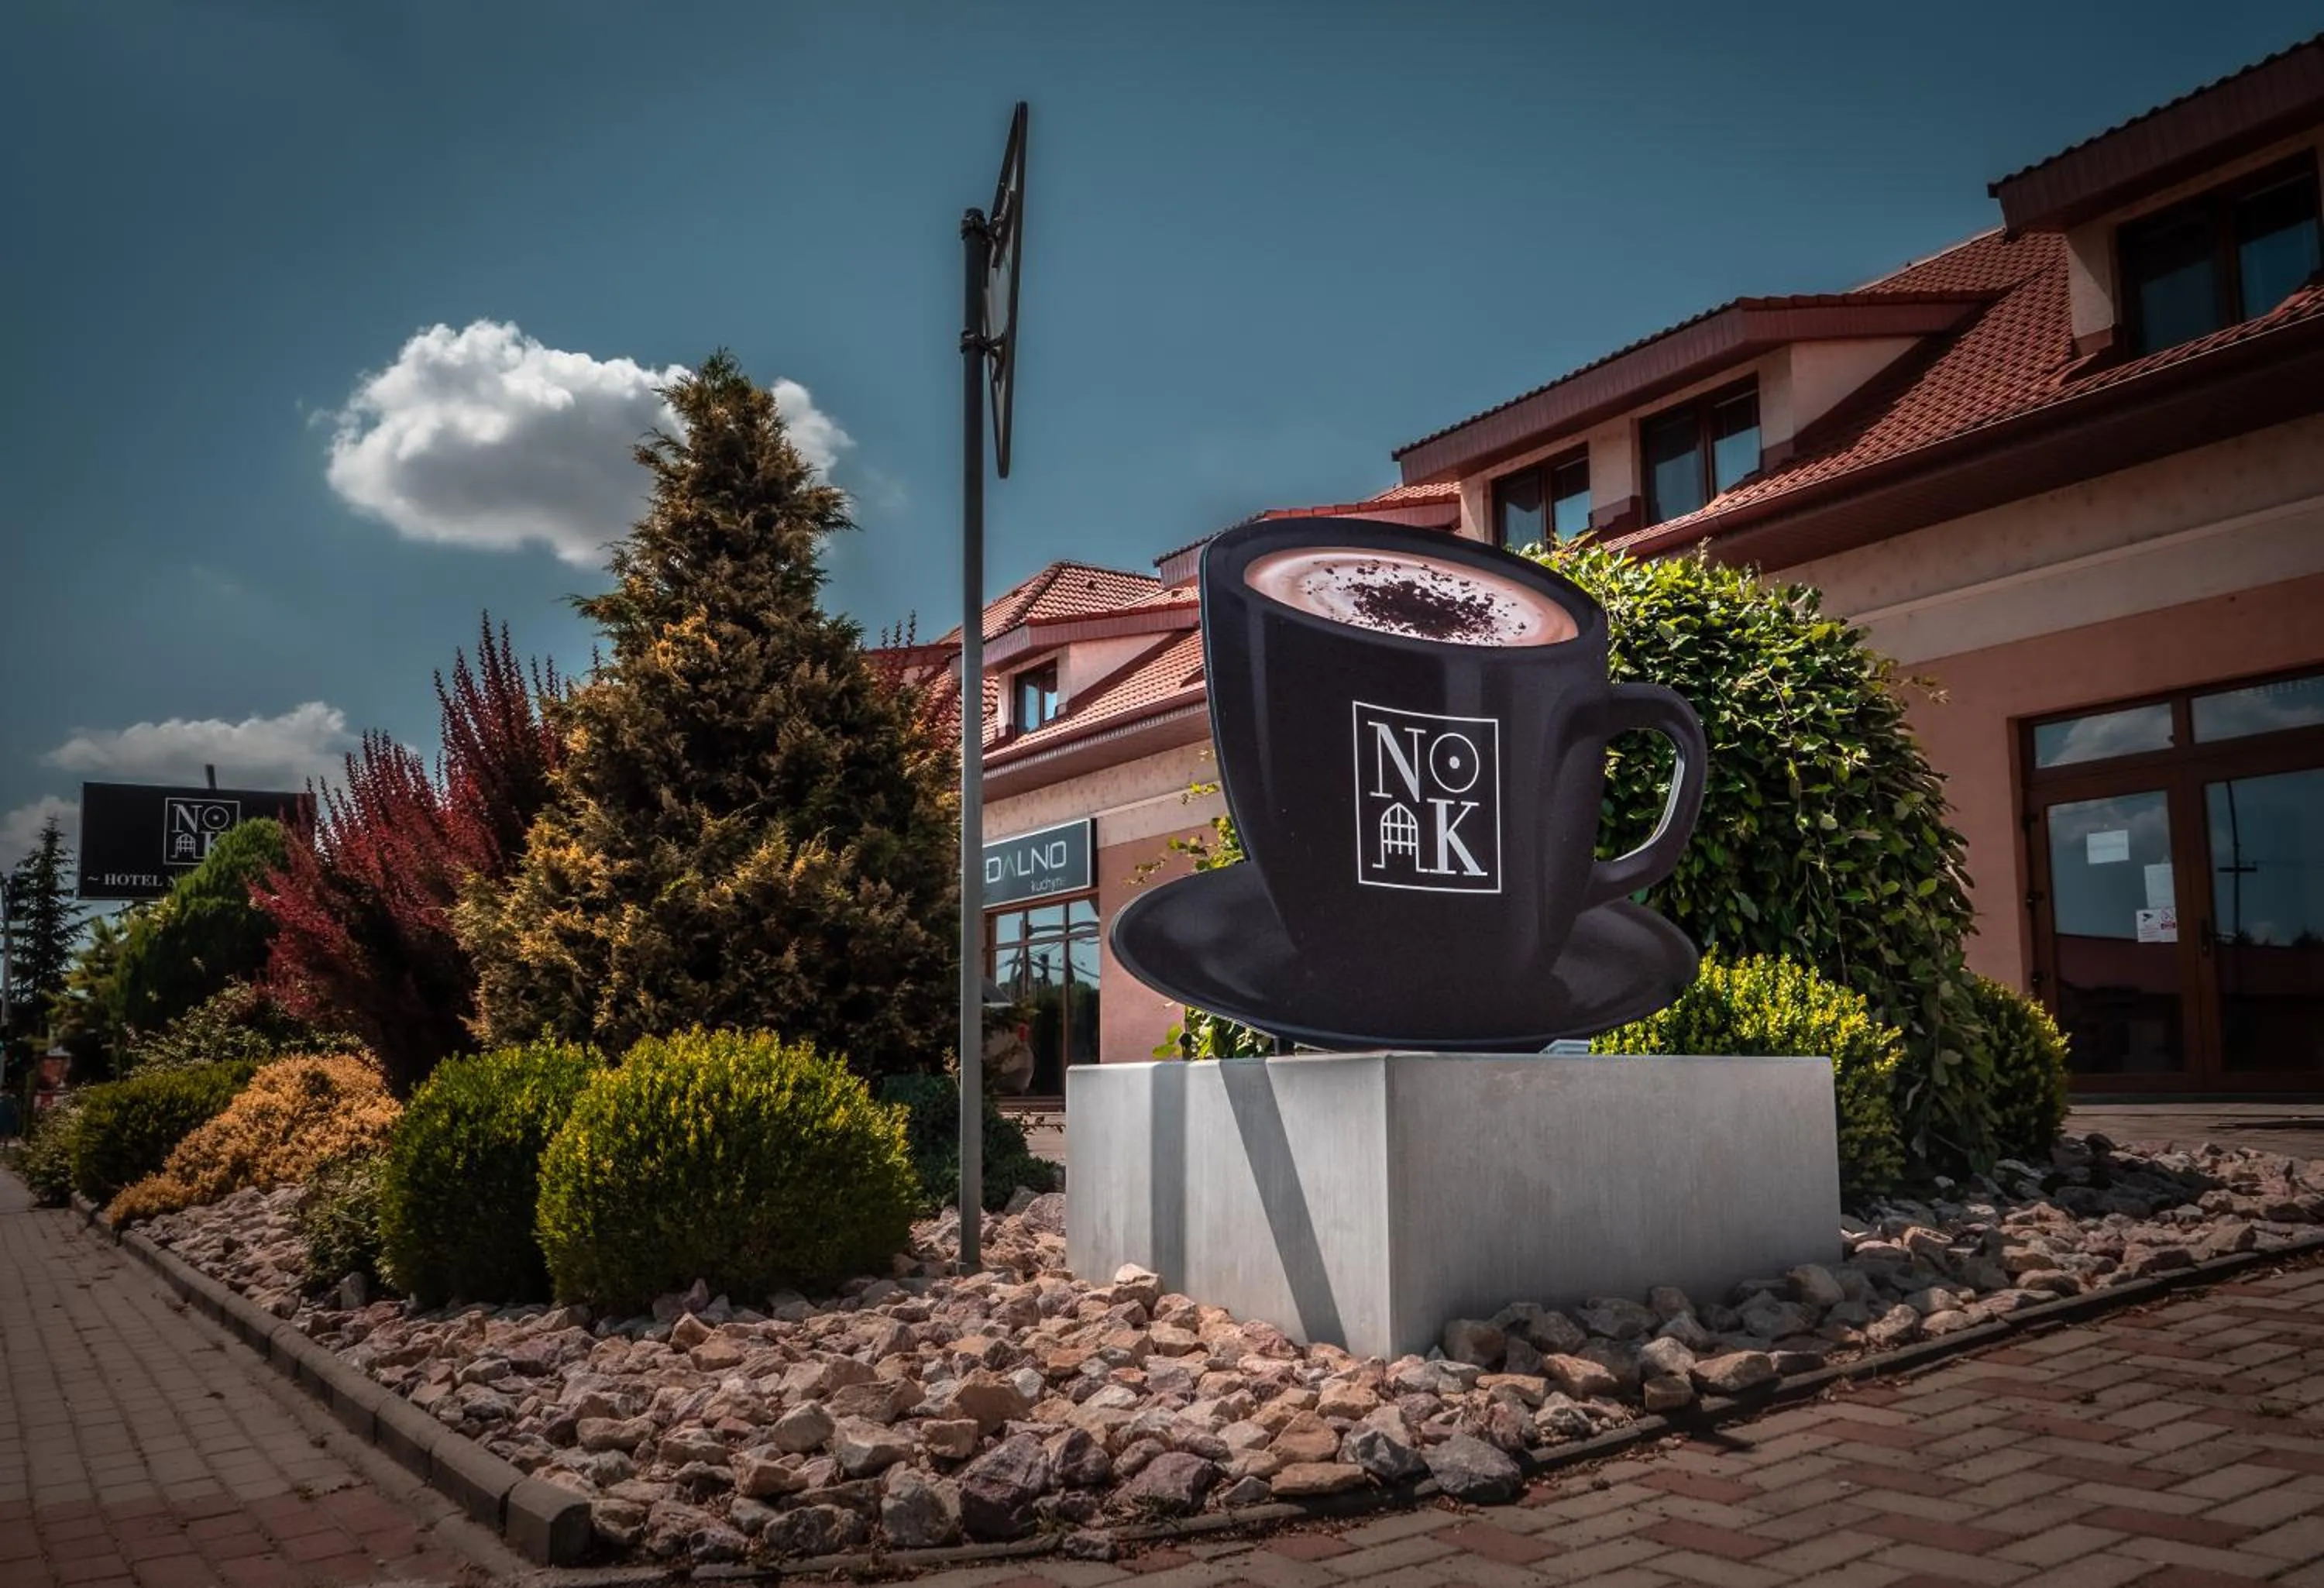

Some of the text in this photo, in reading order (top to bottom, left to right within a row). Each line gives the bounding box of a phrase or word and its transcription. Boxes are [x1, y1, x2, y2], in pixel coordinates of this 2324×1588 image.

[1367, 720, 1480, 803] NO
[104, 873, 163, 887] HOTEL
[985, 840, 1067, 884] DALNO
